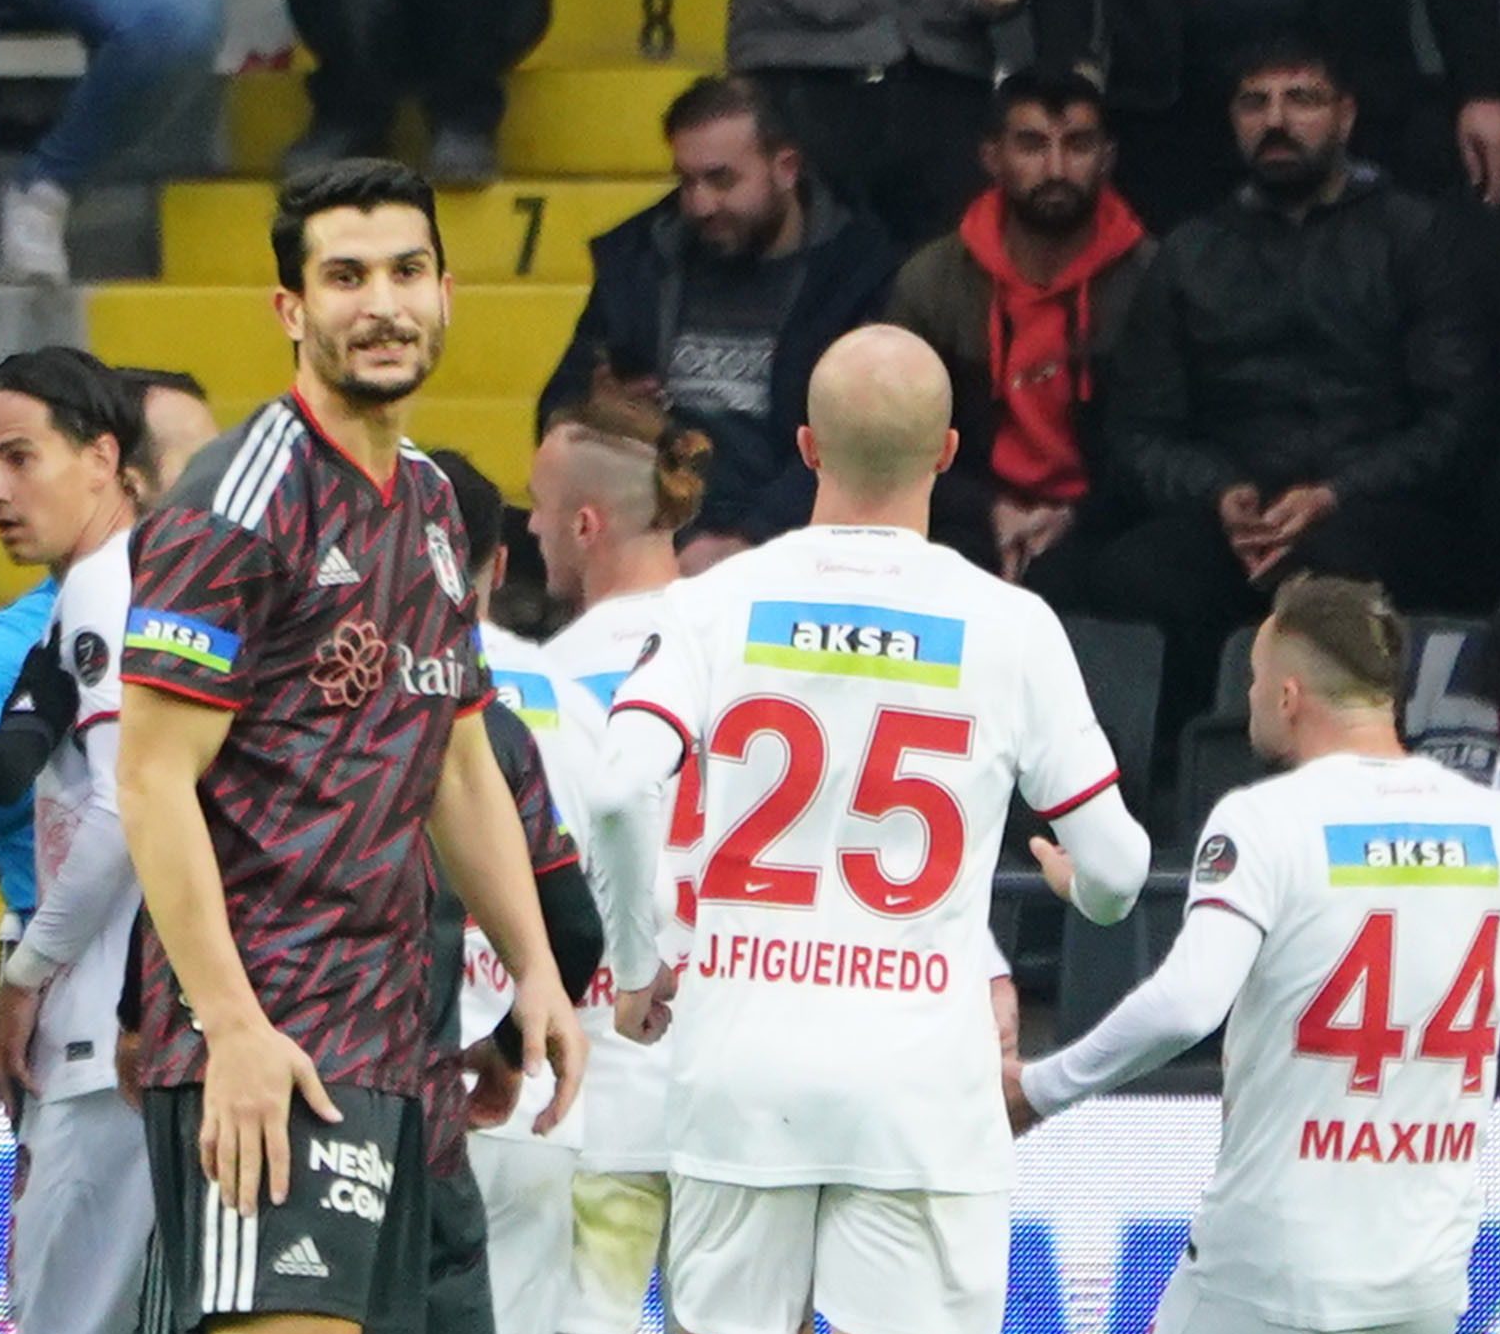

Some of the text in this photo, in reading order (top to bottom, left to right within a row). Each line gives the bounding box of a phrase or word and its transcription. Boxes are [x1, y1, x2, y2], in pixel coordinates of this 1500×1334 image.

[514, 197, 545, 276] 7
[143, 619, 211, 652] aksa
[790, 620, 920, 662] aksa
[696, 694, 975, 921] 25
[1364, 840, 1467, 869] aksa
[698, 933, 951, 996] J.FIGUEIREDO
[1293, 908, 1500, 1099] 44
[1299, 1119, 1476, 1163] MAXIM
